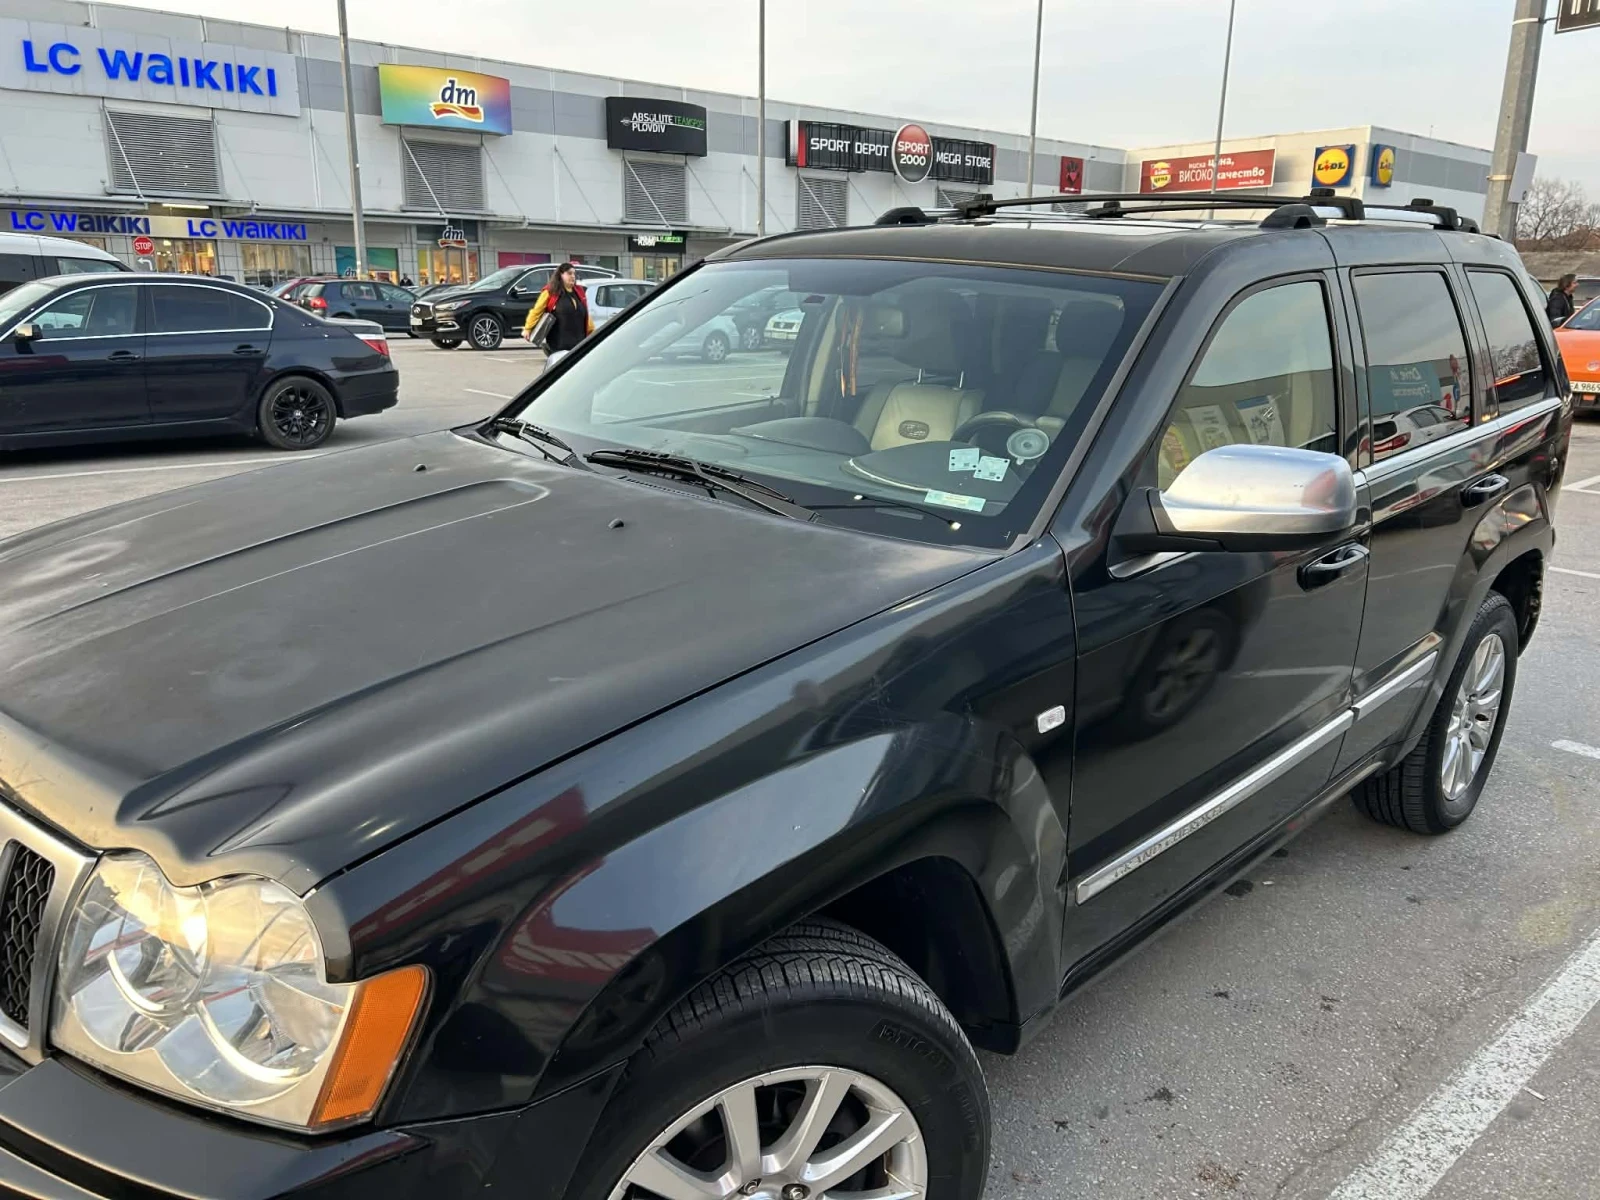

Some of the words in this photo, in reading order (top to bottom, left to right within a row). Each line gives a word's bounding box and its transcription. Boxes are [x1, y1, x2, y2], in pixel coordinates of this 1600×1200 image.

[22, 40, 81, 75] LC
[440, 79, 477, 105] dm
[631, 123, 666, 133] PLOVDIV
[810, 137, 851, 153] SPORT
[855, 142, 889, 157] DEPOT
[897, 140, 930, 153] SPORT
[899, 153, 926, 166] 2000
[936, 151, 962, 165] MEGA
[965, 155, 992, 169] STORE
[1178, 168, 1213, 183] ВИСОКО
[11, 211, 45, 231] LC
[187, 219, 218, 237] LC
[443, 226, 463, 240] dm
[135, 241, 152, 251] STOP
